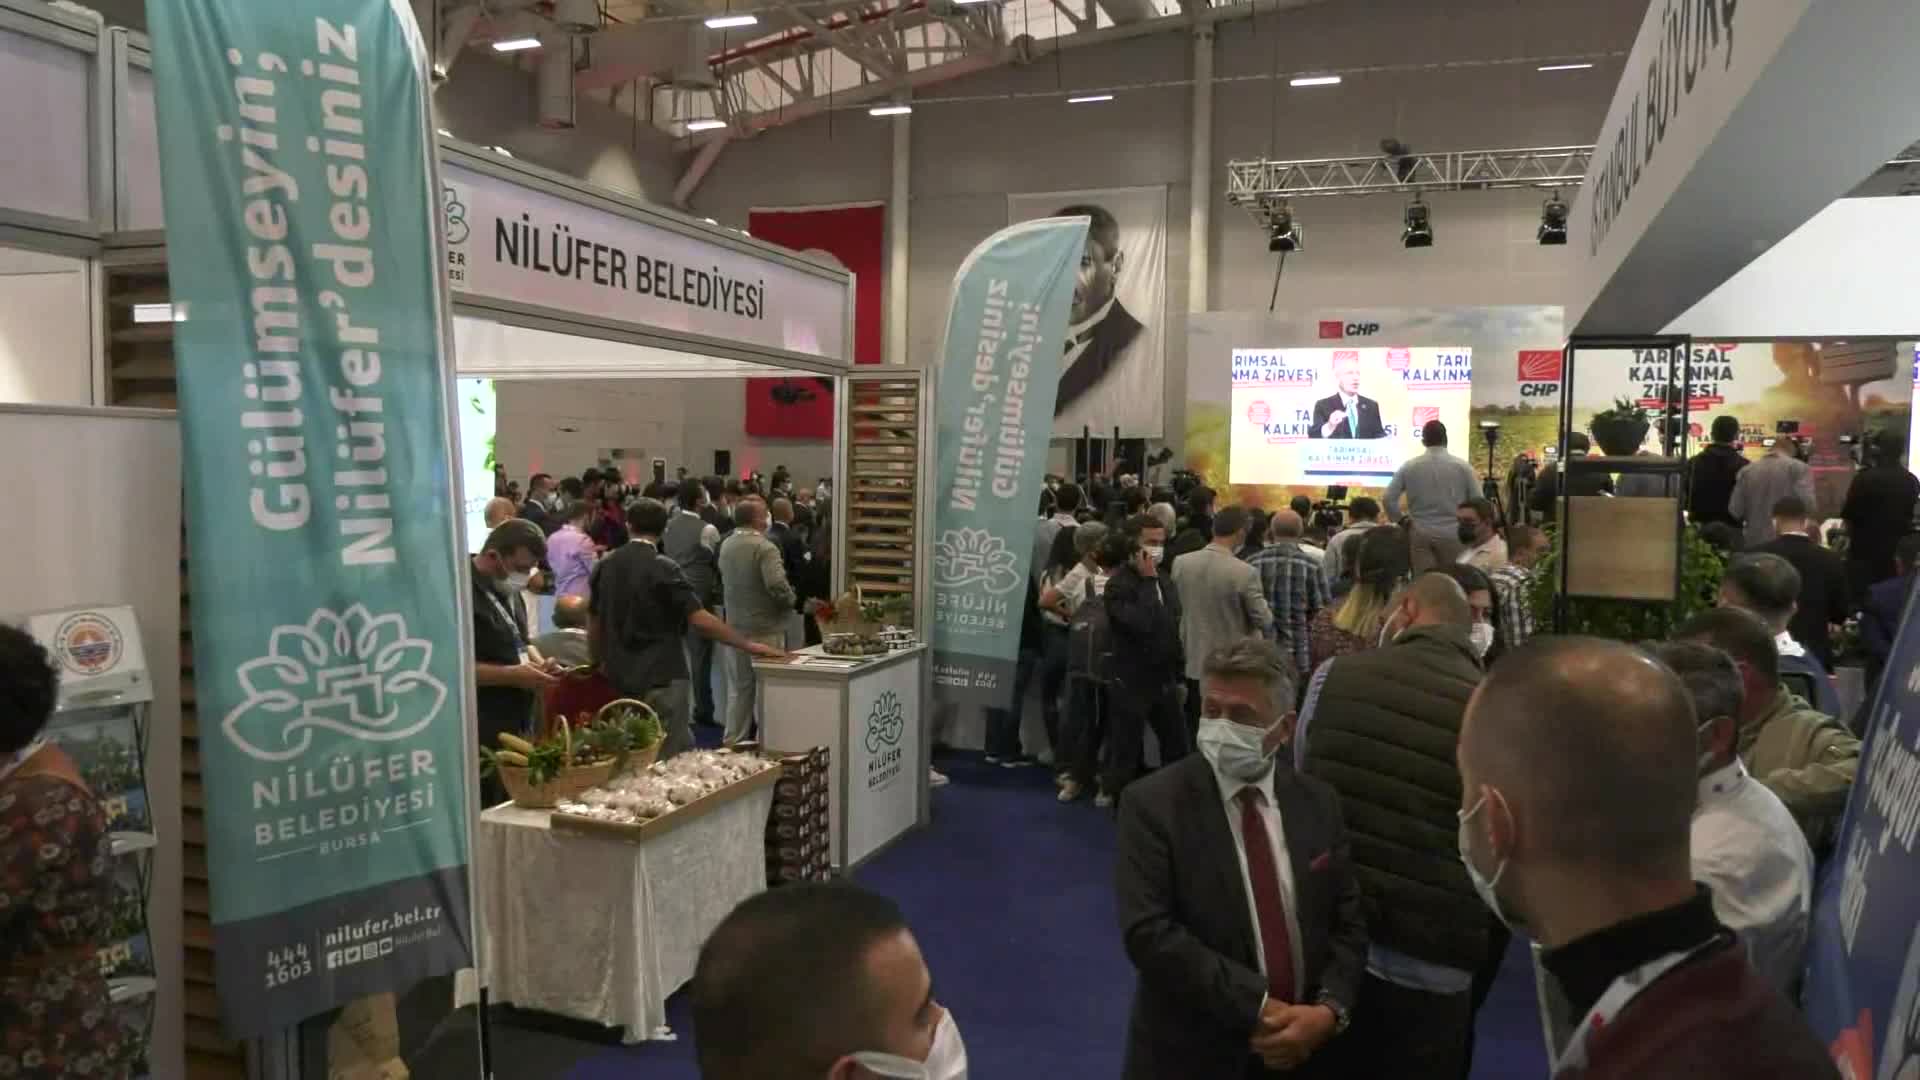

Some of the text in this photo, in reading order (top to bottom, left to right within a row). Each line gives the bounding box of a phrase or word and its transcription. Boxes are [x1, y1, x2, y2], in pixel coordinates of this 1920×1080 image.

[495, 212, 764, 320] NİLÜFER BELEDİYESİ
[1345, 323, 1379, 336] CHP
[1437, 354, 1472, 367] TARI
[1520, 383, 1558, 397] CHP
[253, 749, 437, 809] NİLÜFER
[255, 782, 434, 846] BELEDİYESİ
[319, 831, 382, 855] BURSA
[325, 905, 441, 947] nilufer.bel.tr
[267, 943, 308, 969] 444
[264, 960, 313, 990] 1603
